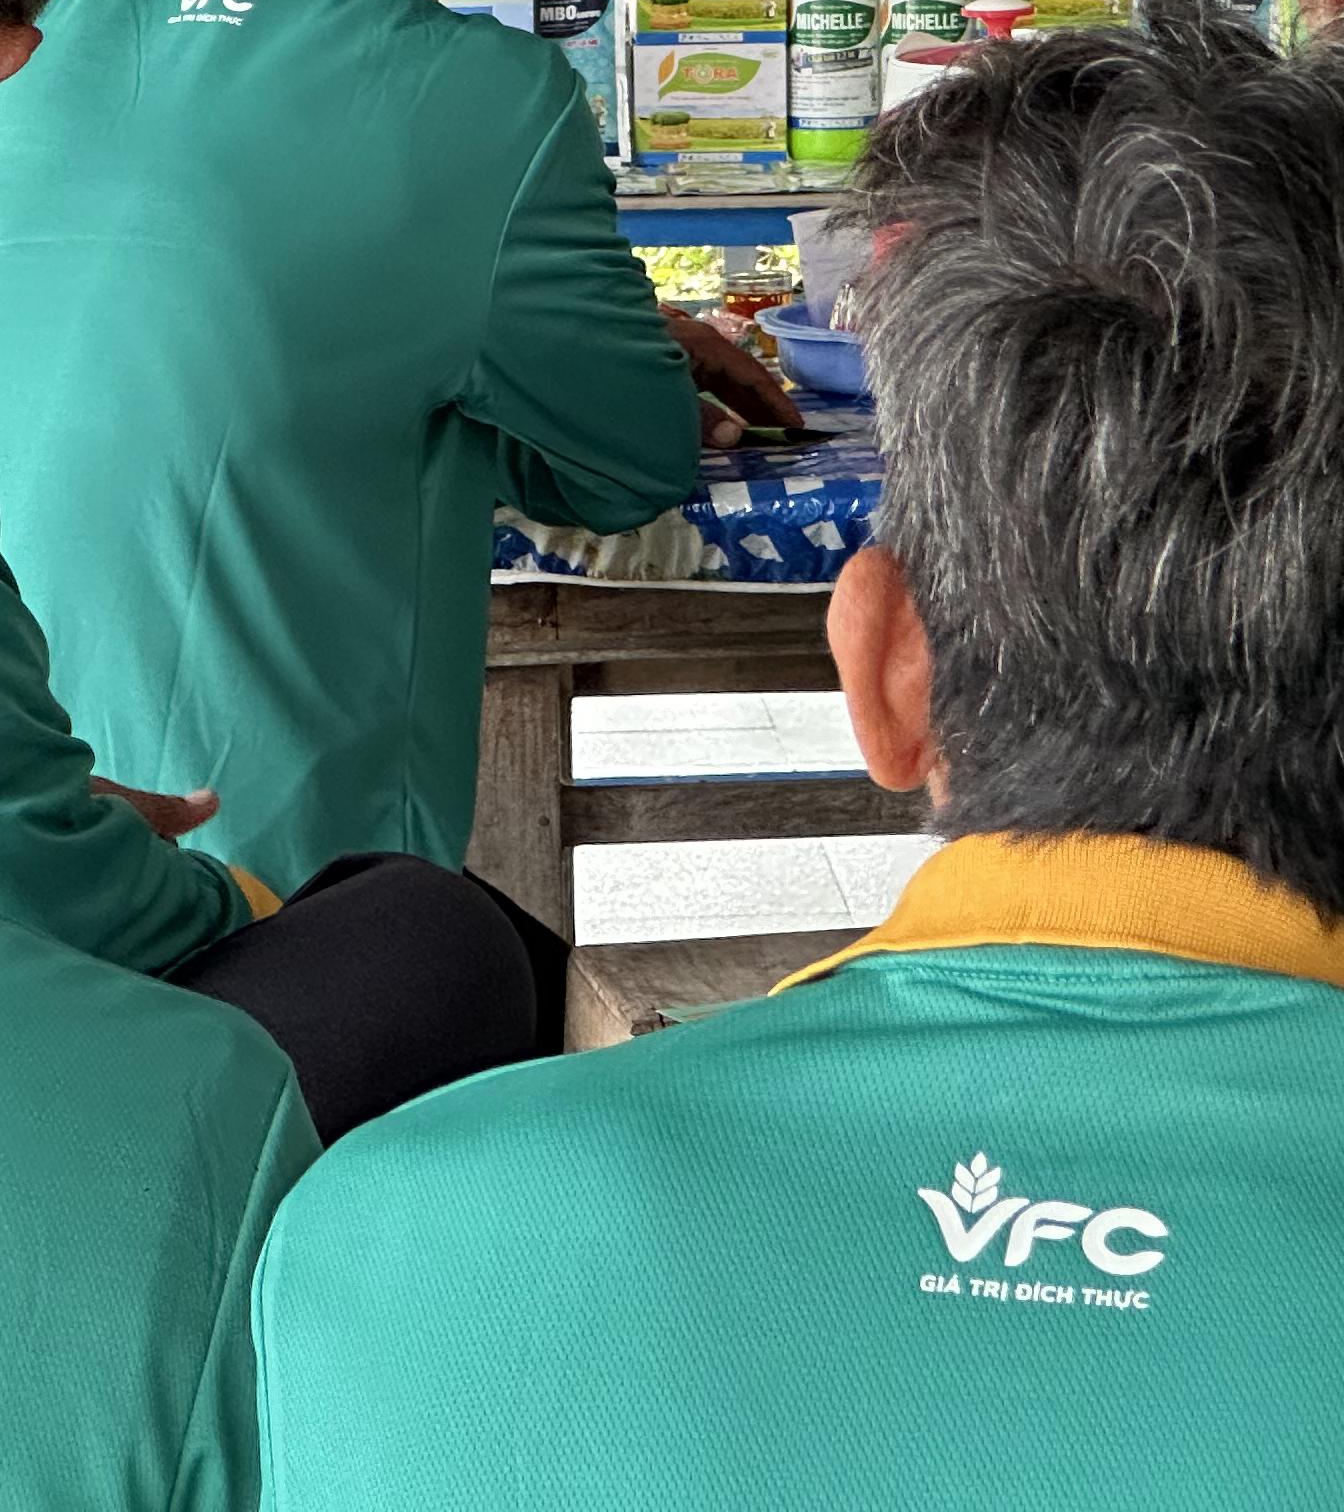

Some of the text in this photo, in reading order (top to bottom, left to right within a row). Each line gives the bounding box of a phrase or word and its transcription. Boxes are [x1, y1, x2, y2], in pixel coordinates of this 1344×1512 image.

[796, 12, 865, 31] MICHELLE
[891, 12, 959, 31] MICHELLE
[916, 1186, 1170, 1276] VFC
[919, 1273, 1151, 1311] GIÁ TRỊ ĐÍCH THỰC
